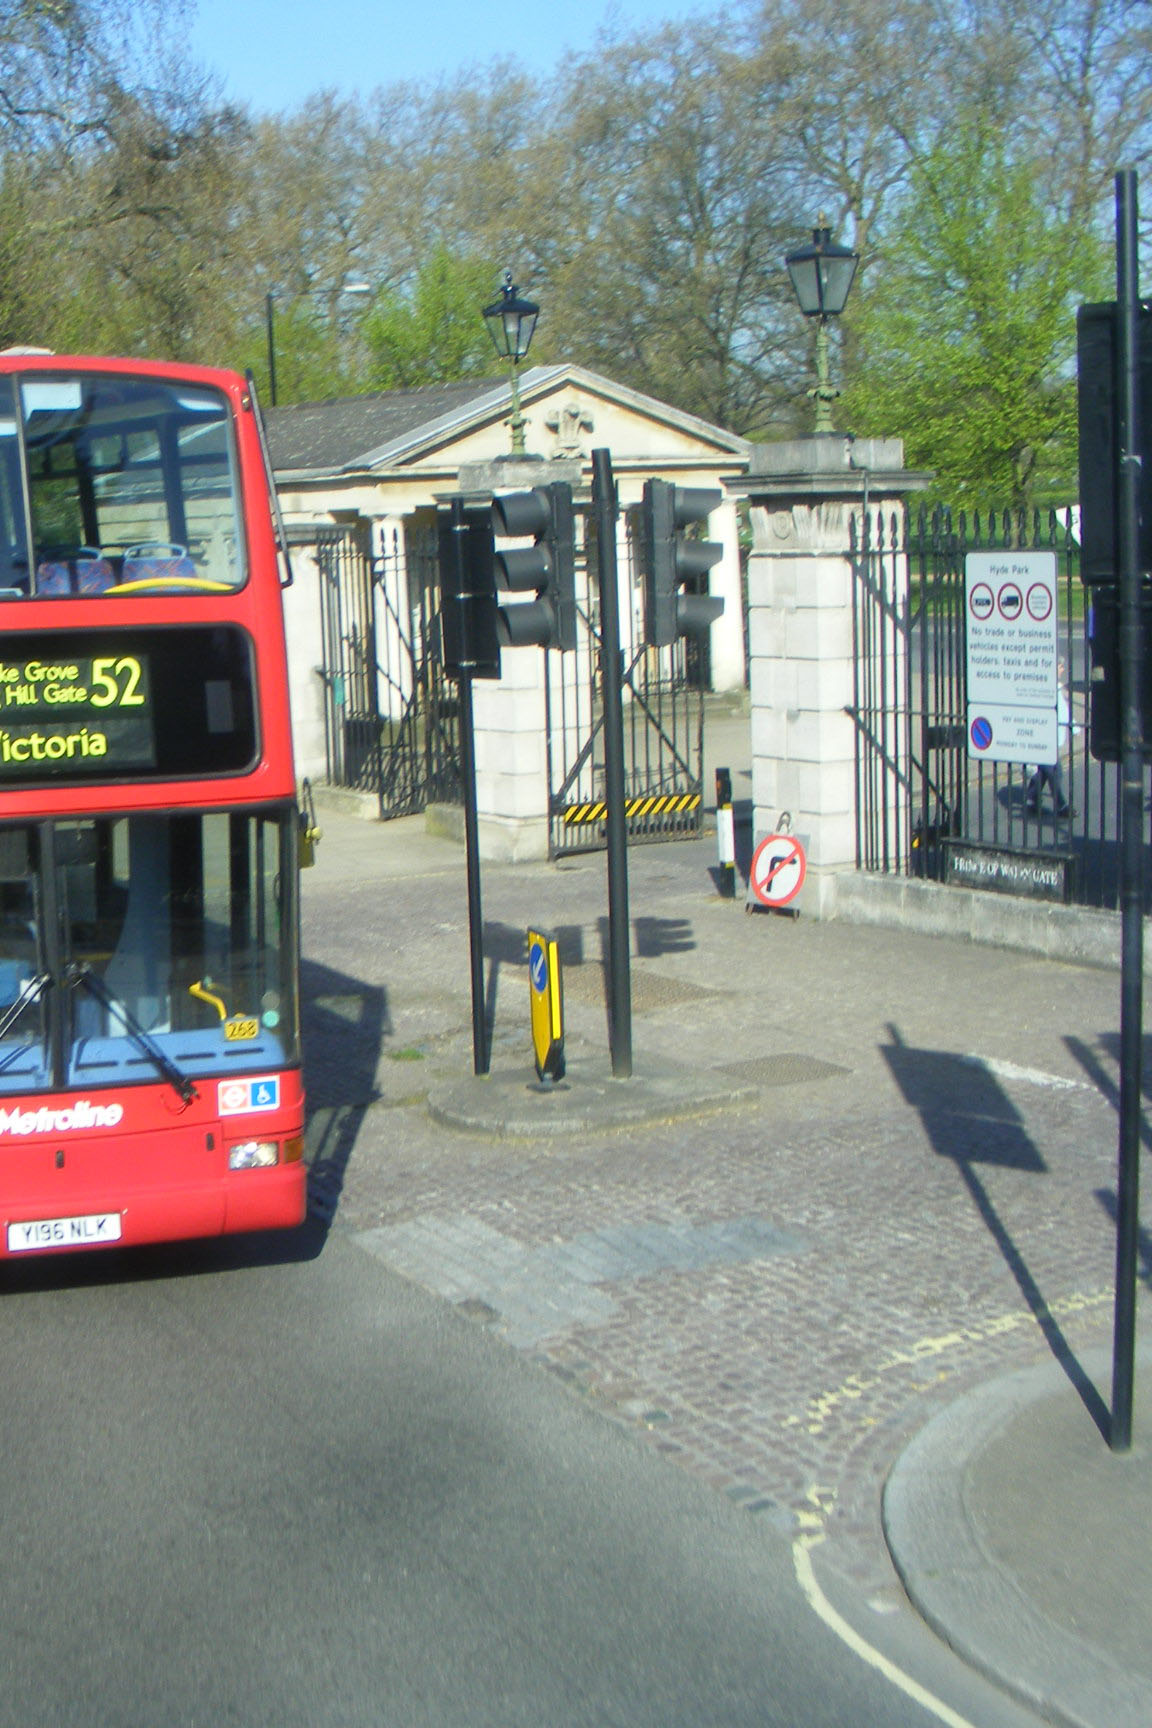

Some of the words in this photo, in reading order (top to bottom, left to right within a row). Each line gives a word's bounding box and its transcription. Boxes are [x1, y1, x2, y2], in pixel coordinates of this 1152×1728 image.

[989, 565, 1008, 575] Hyde
[1012, 565, 1028, 574] Park
[971, 627, 982, 636] No
[985, 628, 1004, 637] trade
[1018, 629, 1051, 639] business
[970, 643, 998, 651] vehicles
[1001, 643, 1026, 653] except
[1029, 645, 1054, 654] permit
[1003, 657, 1020, 667] taxis
[1024, 659, 1038, 668] and
[1042, 659, 1052, 668] for
[24, 661, 78, 682] Grove
[976, 670, 1000, 679] access
[1003, 671, 1010, 680] to
[1014, 672, 1047, 682] premises
[89, 657, 145, 708] 52
[5, 685, 39, 706] Hill
[43, 683, 87, 705] Gate
[1027, 718, 1048, 726] DISPLAY
[1016, 729, 1034, 737] ZONE
[953, 856, 986, 875] PRINE
[987, 861, 999, 876] OF
[1032, 869, 1058, 887] GATE
[22, 1223, 65, 1242] Y196
[70, 1217, 107, 1238] NLK
